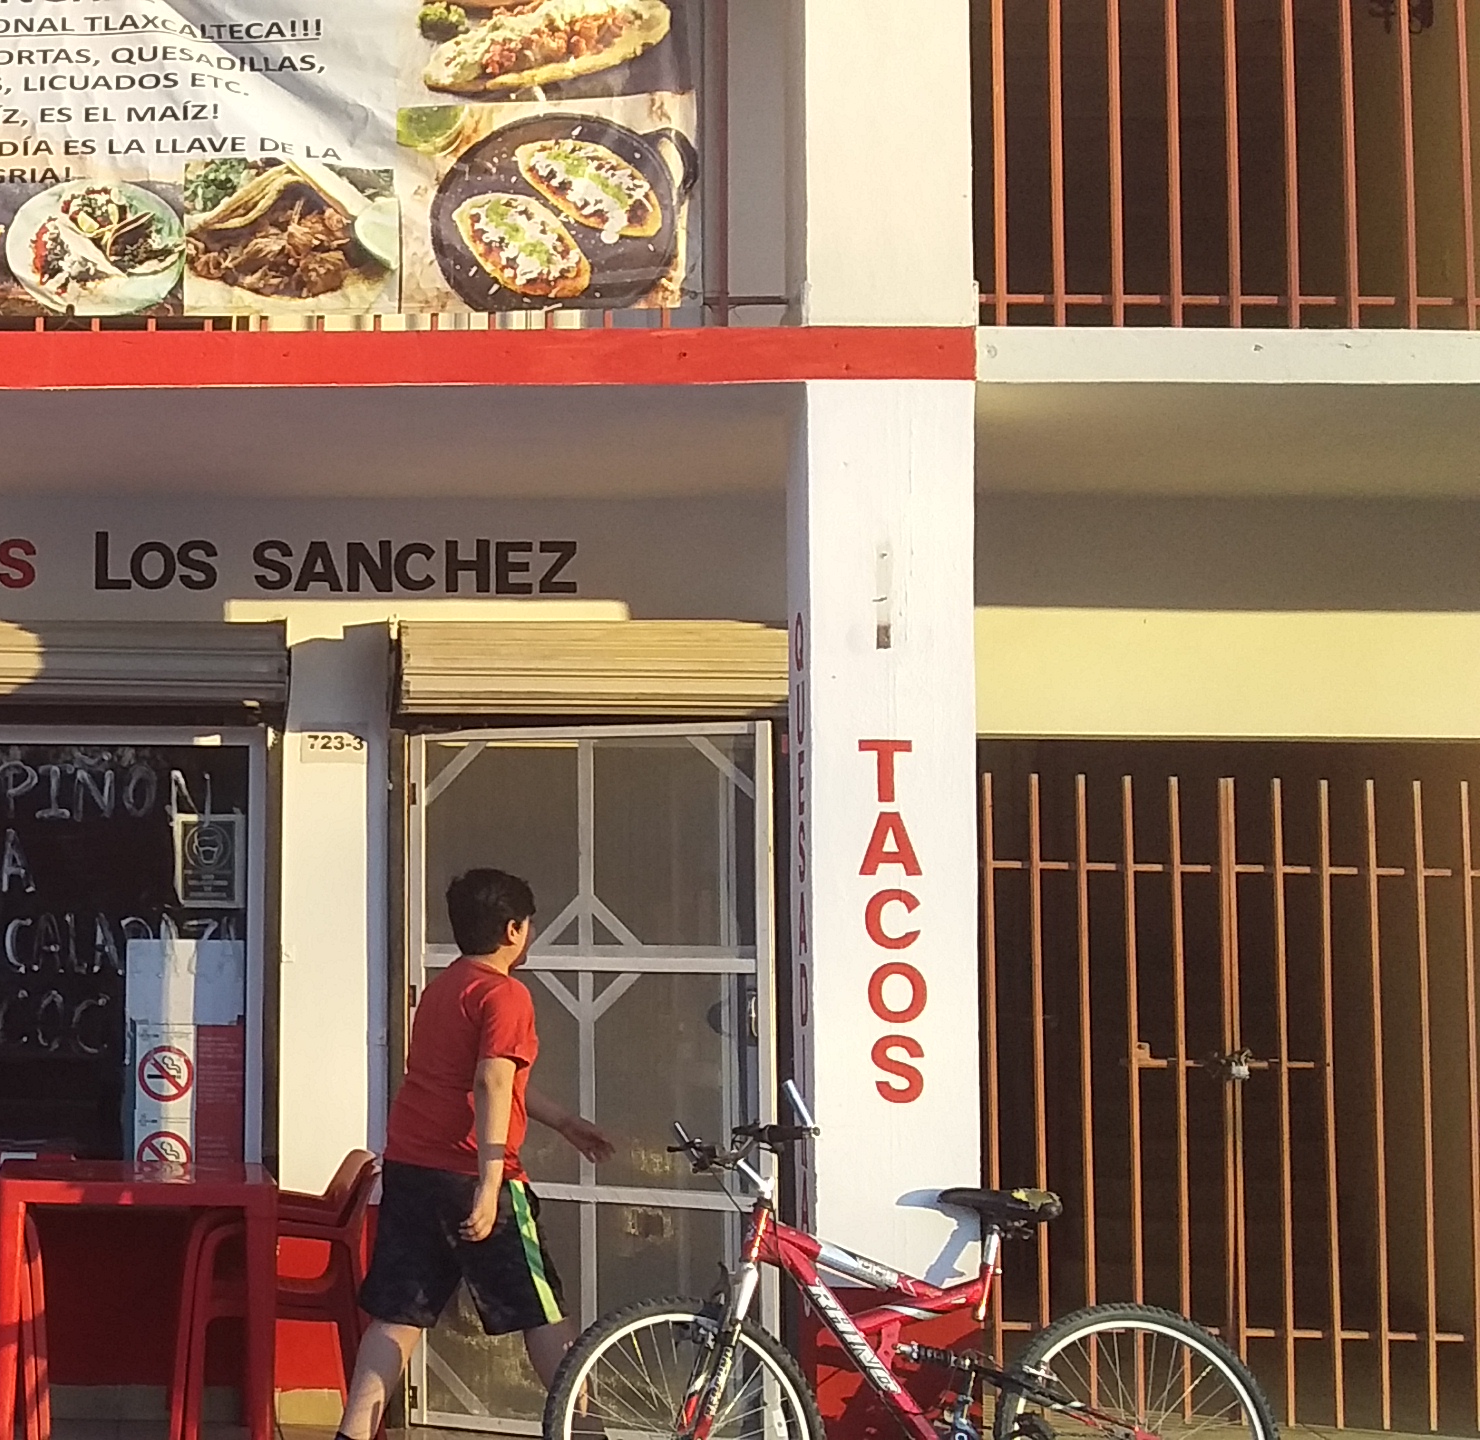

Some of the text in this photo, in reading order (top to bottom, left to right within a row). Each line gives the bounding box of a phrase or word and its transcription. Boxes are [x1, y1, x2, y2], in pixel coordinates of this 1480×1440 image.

[84, 14, 322, 40] TLAXCALTECA!!!
[111, 46, 326, 75] QUESADILLAS,
[23, 73, 179, 92] LICUADOS
[191, 72, 250, 97] ETC.
[39, 107, 73, 123] ES
[84, 107, 117, 123] EL
[127, 101, 219, 123] MAÍZ!
[64, 138, 96, 156] ES
[108, 138, 146, 155] LA
[155, 136, 246, 154] LLAVE
[258, 136, 295, 155] DE
[305, 144, 342, 161] LA
[94, 531, 578, 595] LOS SANCHEZ
[307, 734, 364, 751] 723-3
[858, 738, 928, 1104] TACOS
[807, 1277, 902, 1394] RHINO
